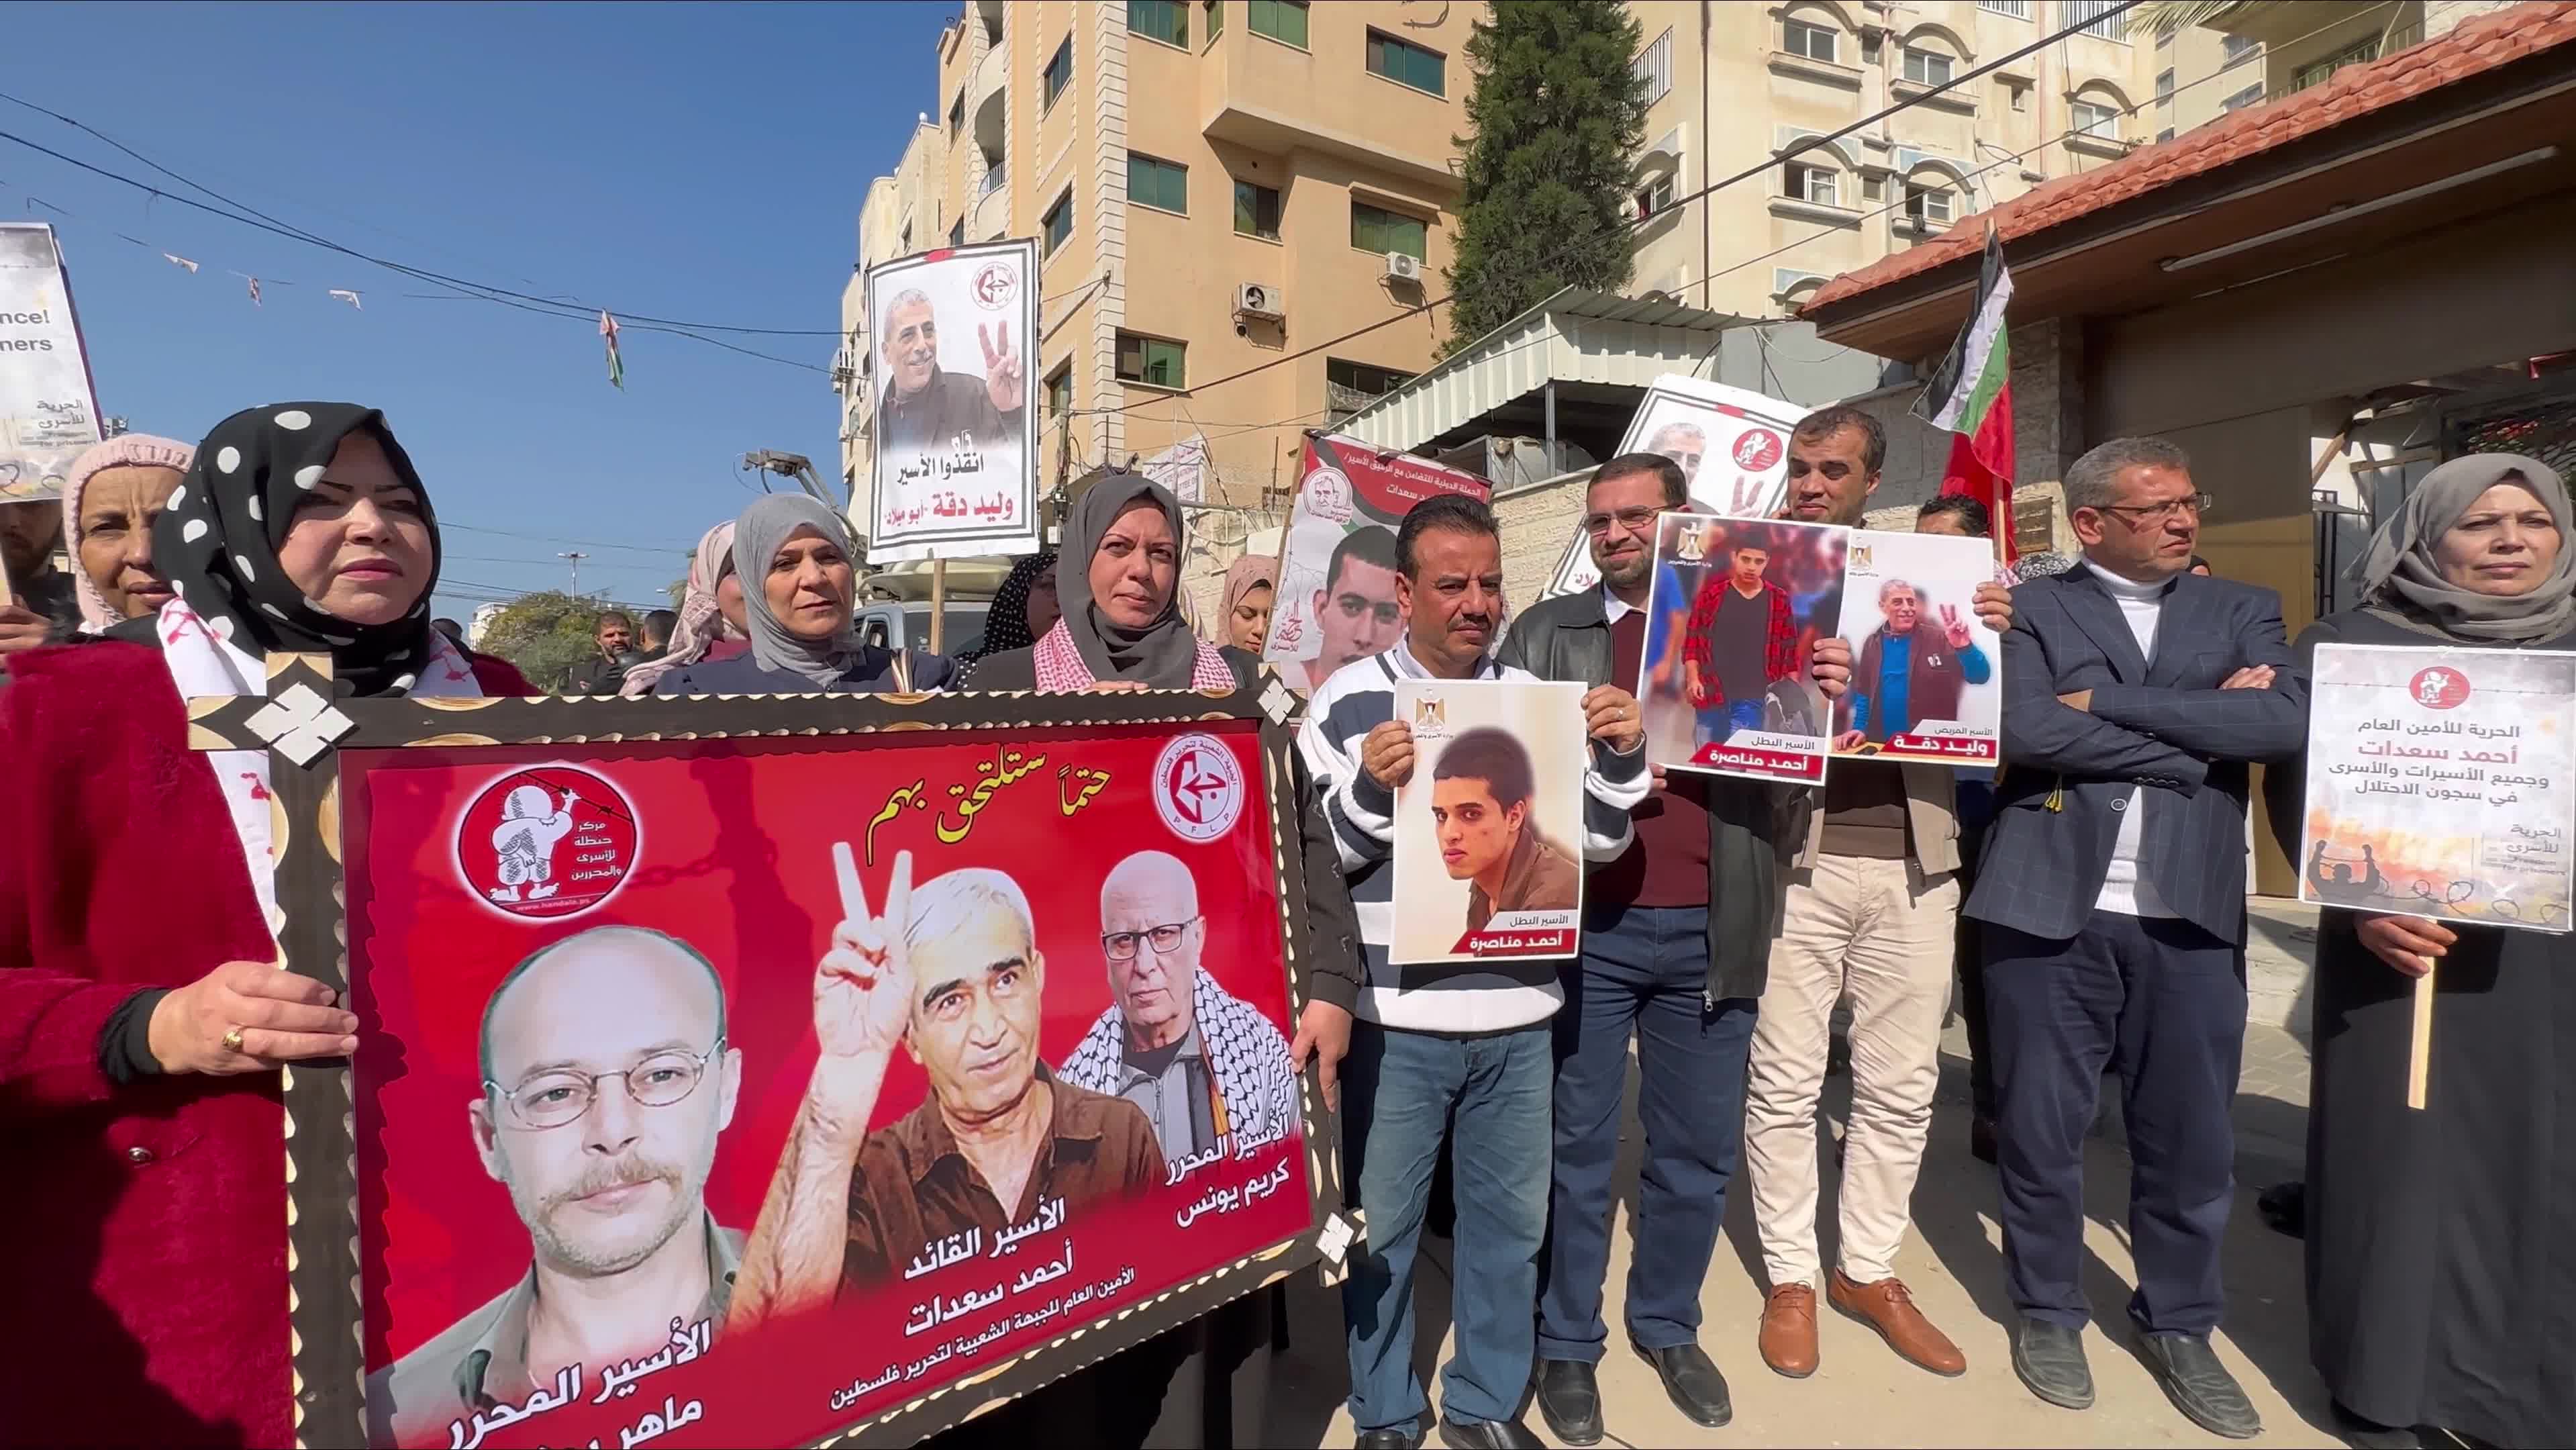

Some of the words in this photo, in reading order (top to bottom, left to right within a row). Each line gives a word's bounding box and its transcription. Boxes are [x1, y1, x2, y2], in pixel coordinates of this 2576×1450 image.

[38, 399, 83, 413] الحرية
[38, 412, 85, 428] للأسرى
[897, 452, 936, 485] الأسير
[1393, 466, 1404, 477] مع
[1386, 483, 1418, 499] سعدات
[1434, 476, 1458, 490] الدولية
[1459, 485, 1481, 496] الحملة
[932, 491, 967, 517] دقة
[974, 491, 1013, 522] وليد
[1970, 727, 1993, 736] الأسير
[2357, 718, 2401, 732] العام
[2406, 720, 2462, 736] للأمين
[2469, 724, 2520, 739] الحرية
[1751, 736, 1782, 746] البطل
[1785, 738, 1815, 750] الأسير
[2358, 740, 2449, 760] سعدات
[2459, 745, 2518, 764] أحمد
[1710, 750, 1765, 767] مناصرة
[1767, 756, 1809, 771] أحمد
[2328, 761, 2398, 777] والأسرى
[2405, 763, 2484, 781] الأسيرات
[2355, 779, 2420, 795] الاحتلال
[2491, 772, 2550, 789] وجميع
[2426, 786, 2481, 802] سجون
[2489, 791, 2518, 807] في
[578, 821, 606, 833] مركز
[865, 779, 928, 867] بهم
[2511, 824, 2561, 838] الحرية
[574, 834, 613, 847] حنظلة
[2507, 840, 2559, 854] للأسرى
[576, 849, 616, 863] للأسرى
[571, 865, 623, 881] والمحررين
[1509, 916, 1539, 928] البطل
[1541, 914, 1569, 926] الأسير
[1470, 936, 1522, 952] مناصرة
[1525, 930, 1563, 947] أحمد
[1235, 1108, 1290, 1161] الأسير
[1165, 1133, 1229, 1186] المحرر
[1244, 1156, 1290, 1208] كريم
[1176, 1186, 1240, 1228] يونس
[989, 1194, 1066, 1259] الأسير
[903, 1226, 982, 1280] القائد
[1011, 1238, 1075, 1294] أحمد
[1097, 1267, 1136, 1298] الأمين
[1062, 1284, 1093, 1316] العام
[903, 1282, 1004, 1337] سعدات
[1013, 1298, 1060, 1331] للجبهة
[954, 1319, 1010, 1357] الشعبية
[592, 1316, 711, 1404] الأسير
[903, 1343, 952, 1382] لتحرير
[829, 1364, 901, 1410] فلسطين
[448, 1363, 583, 1449] المحرر
